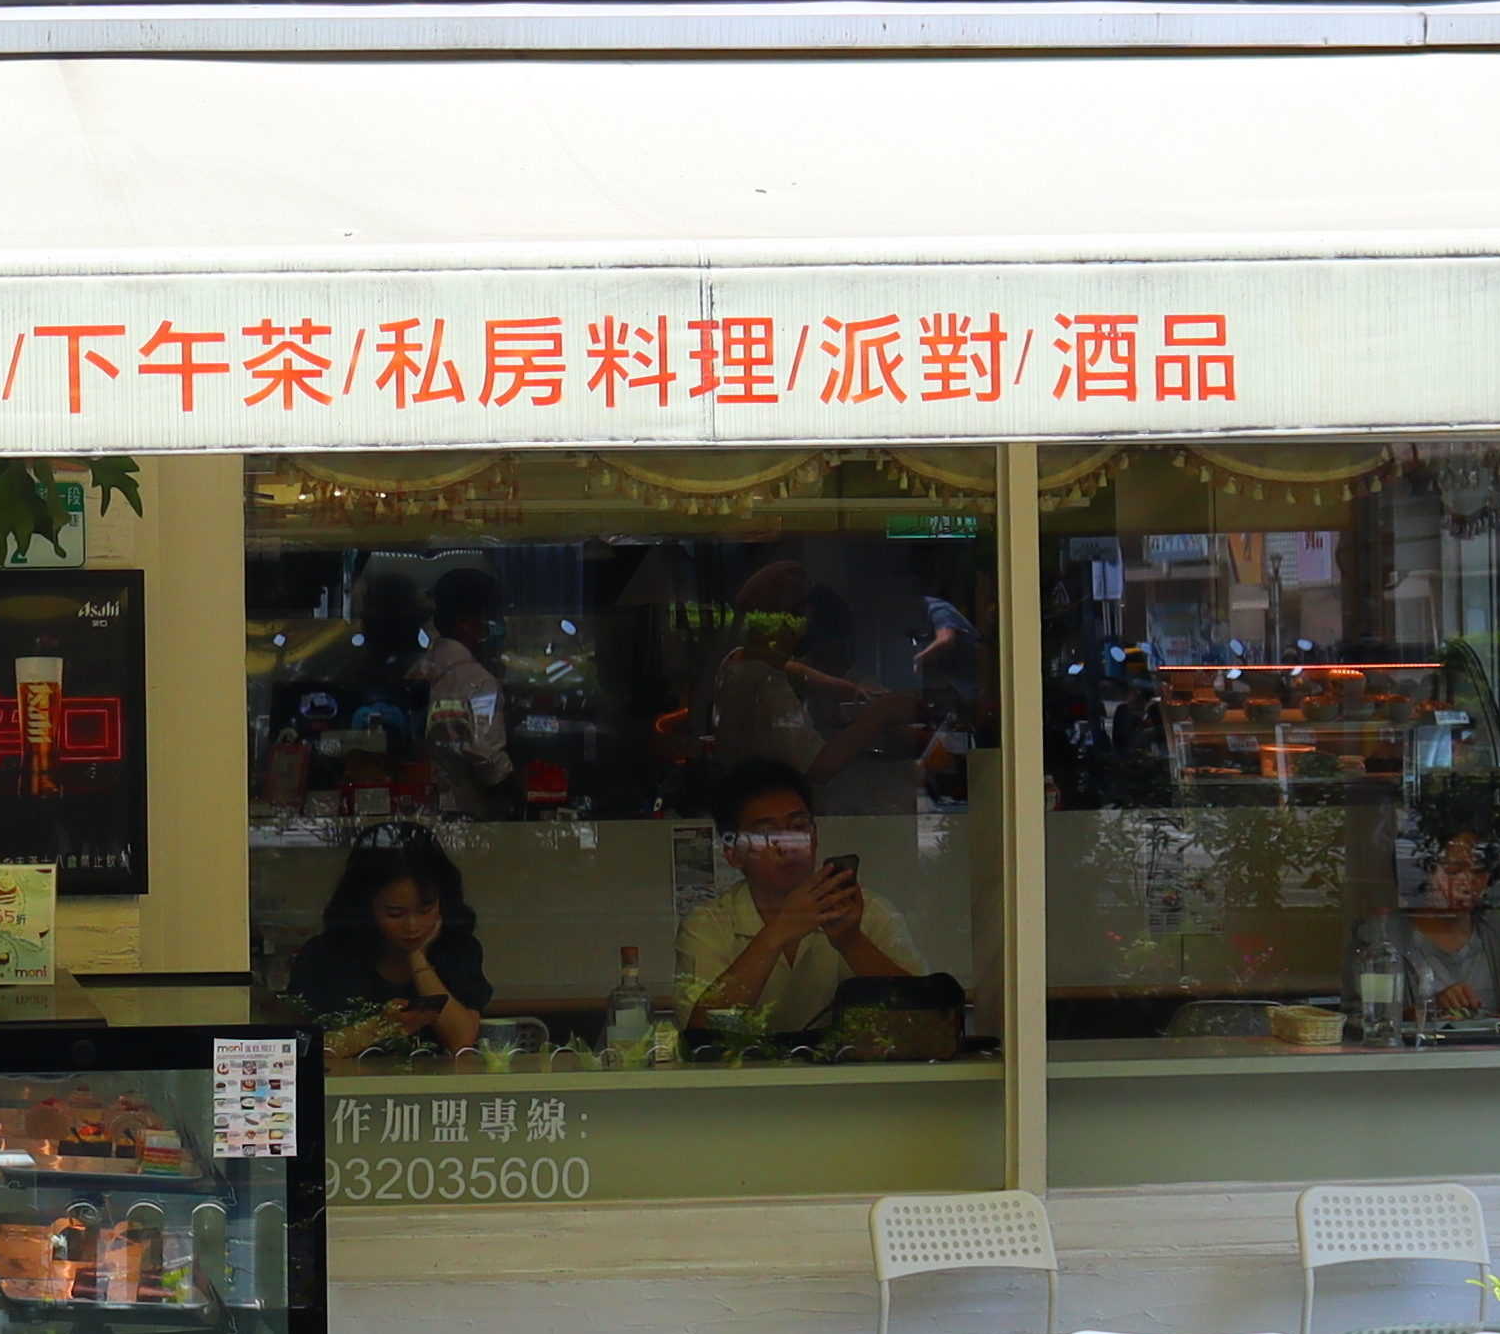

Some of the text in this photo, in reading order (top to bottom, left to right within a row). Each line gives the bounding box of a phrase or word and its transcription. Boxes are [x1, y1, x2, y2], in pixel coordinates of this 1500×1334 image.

[78, 600, 120, 618] Asahi
[27, 682, 54, 744] Asahi
[14, 965, 48, 978] moni
[217, 1041, 243, 1053] moni
